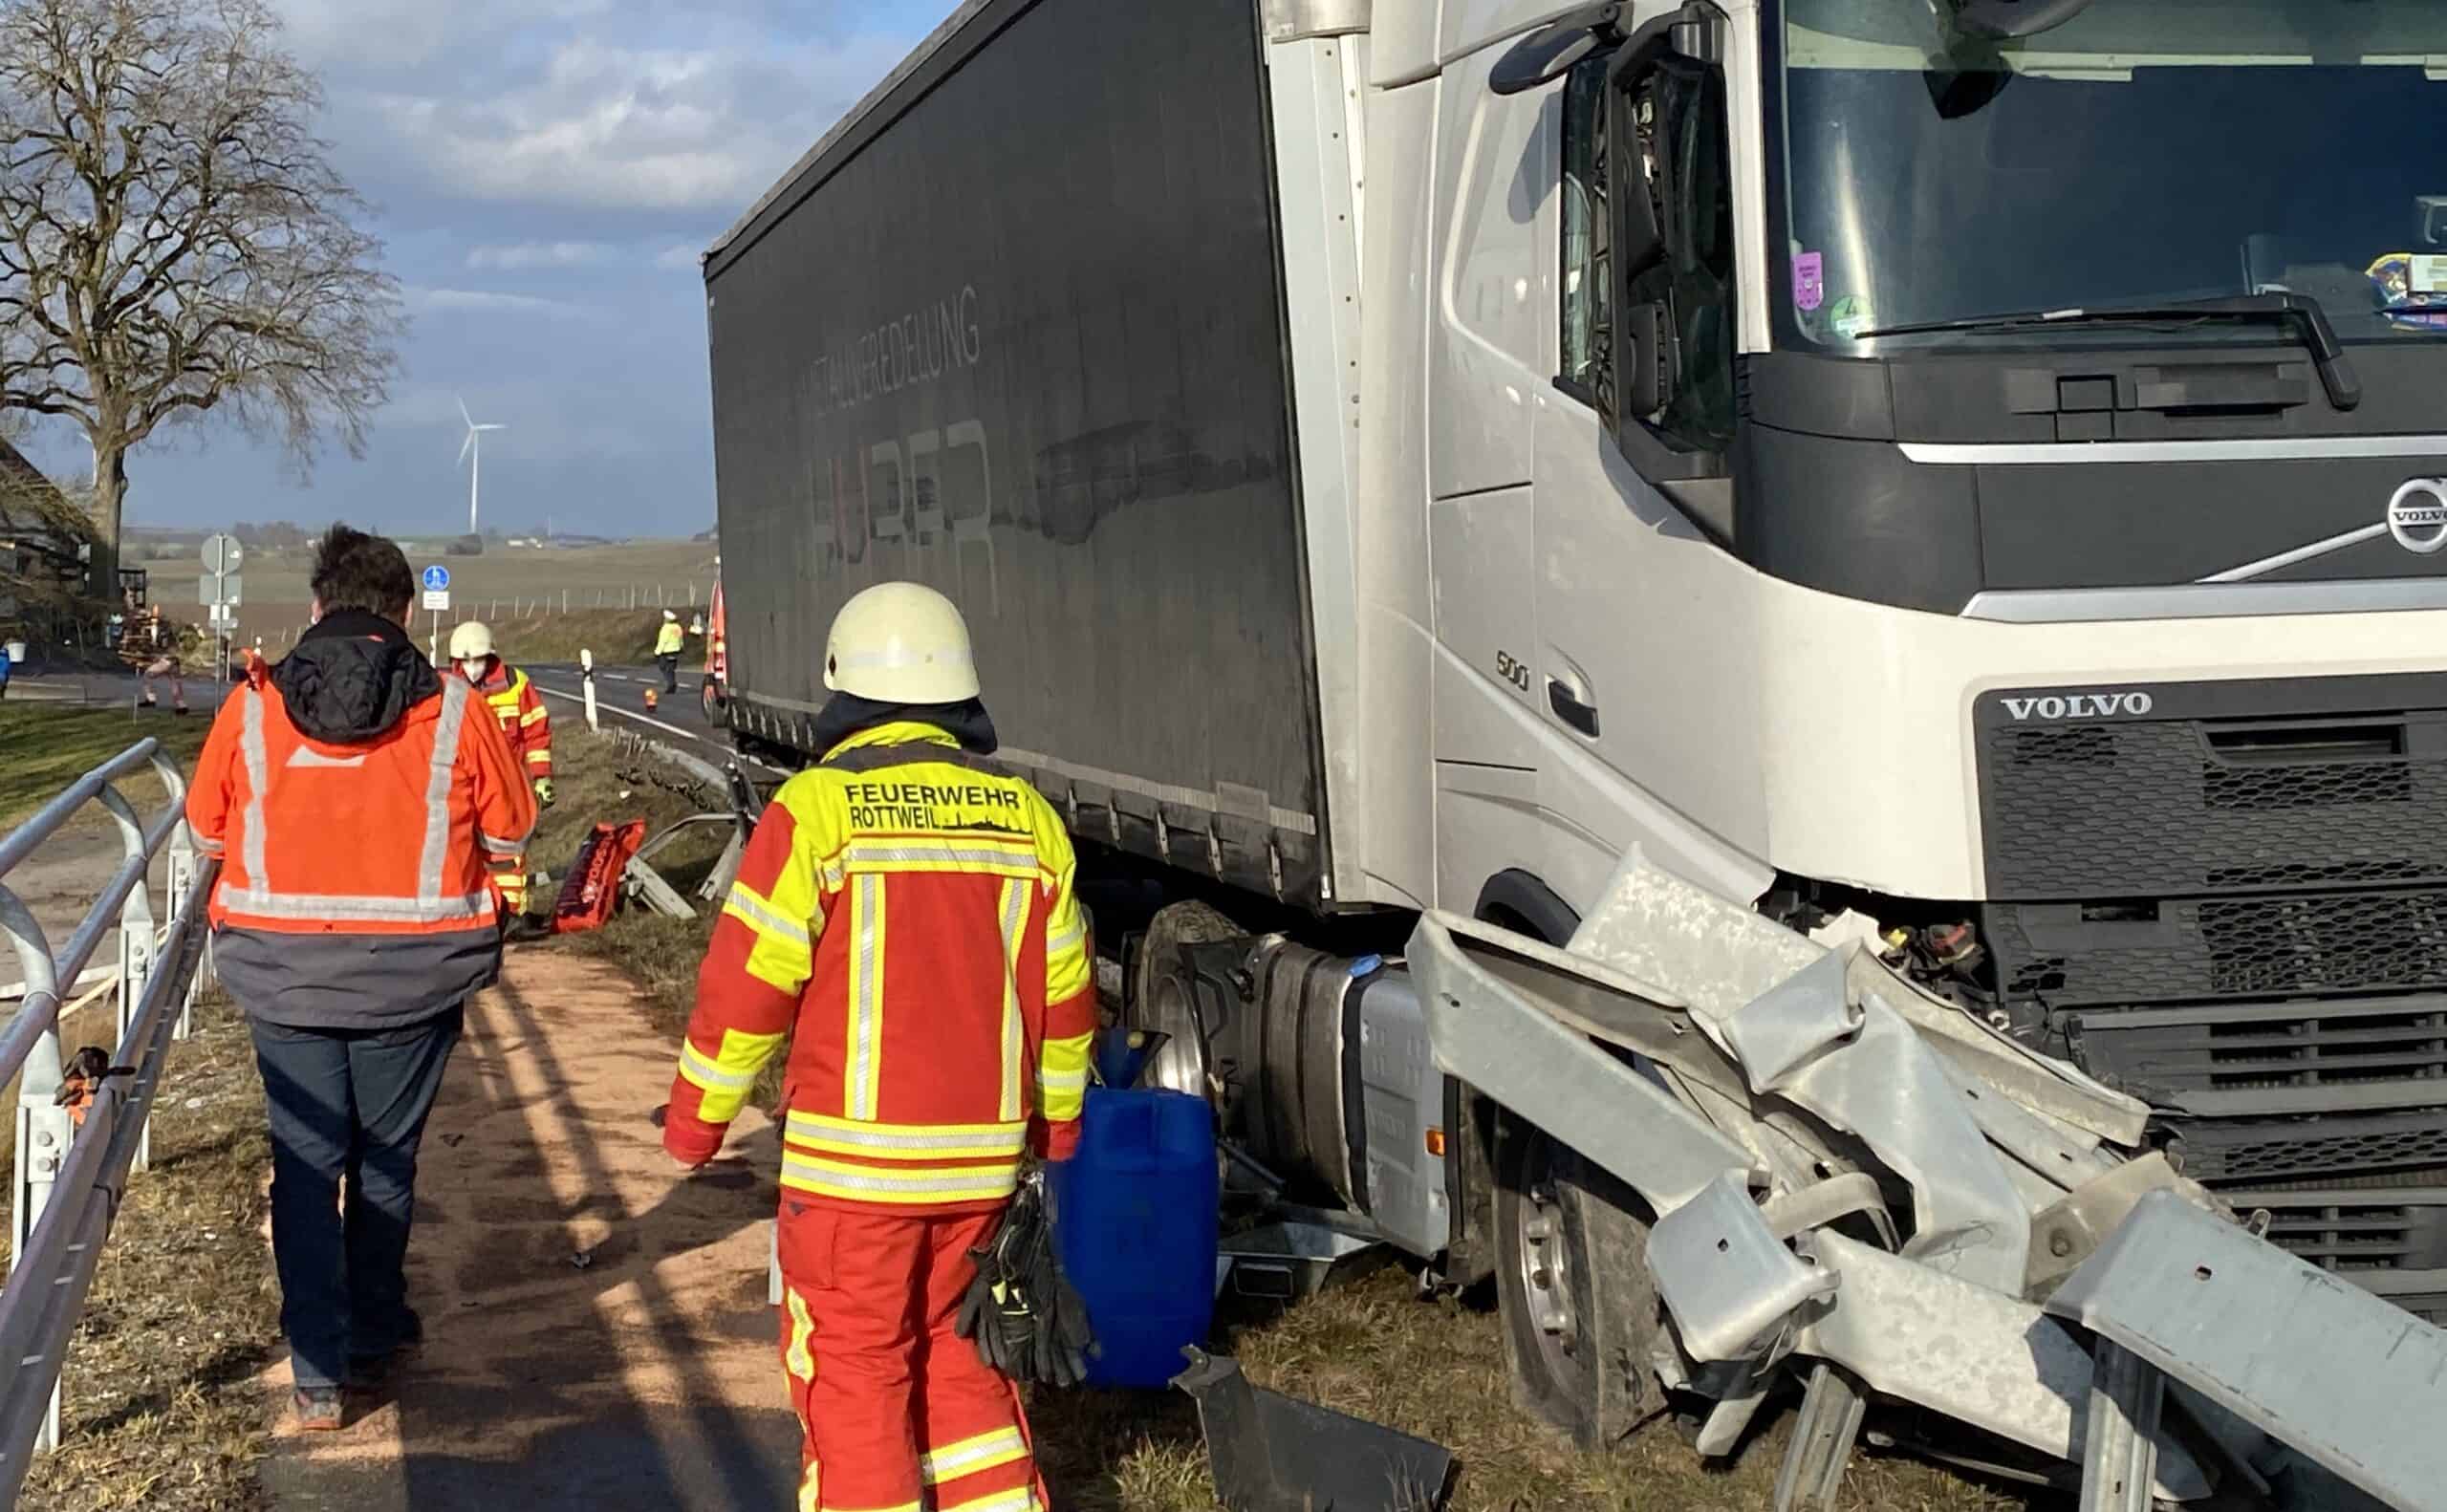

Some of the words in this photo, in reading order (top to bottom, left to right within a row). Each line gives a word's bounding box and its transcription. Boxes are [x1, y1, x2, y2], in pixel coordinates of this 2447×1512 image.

[1498, 650, 1528, 691] 500
[2001, 692, 2152, 720] VOLVO
[844, 784, 1019, 810] FEUERWEHR
[851, 806, 940, 830] ROTTWEIL
